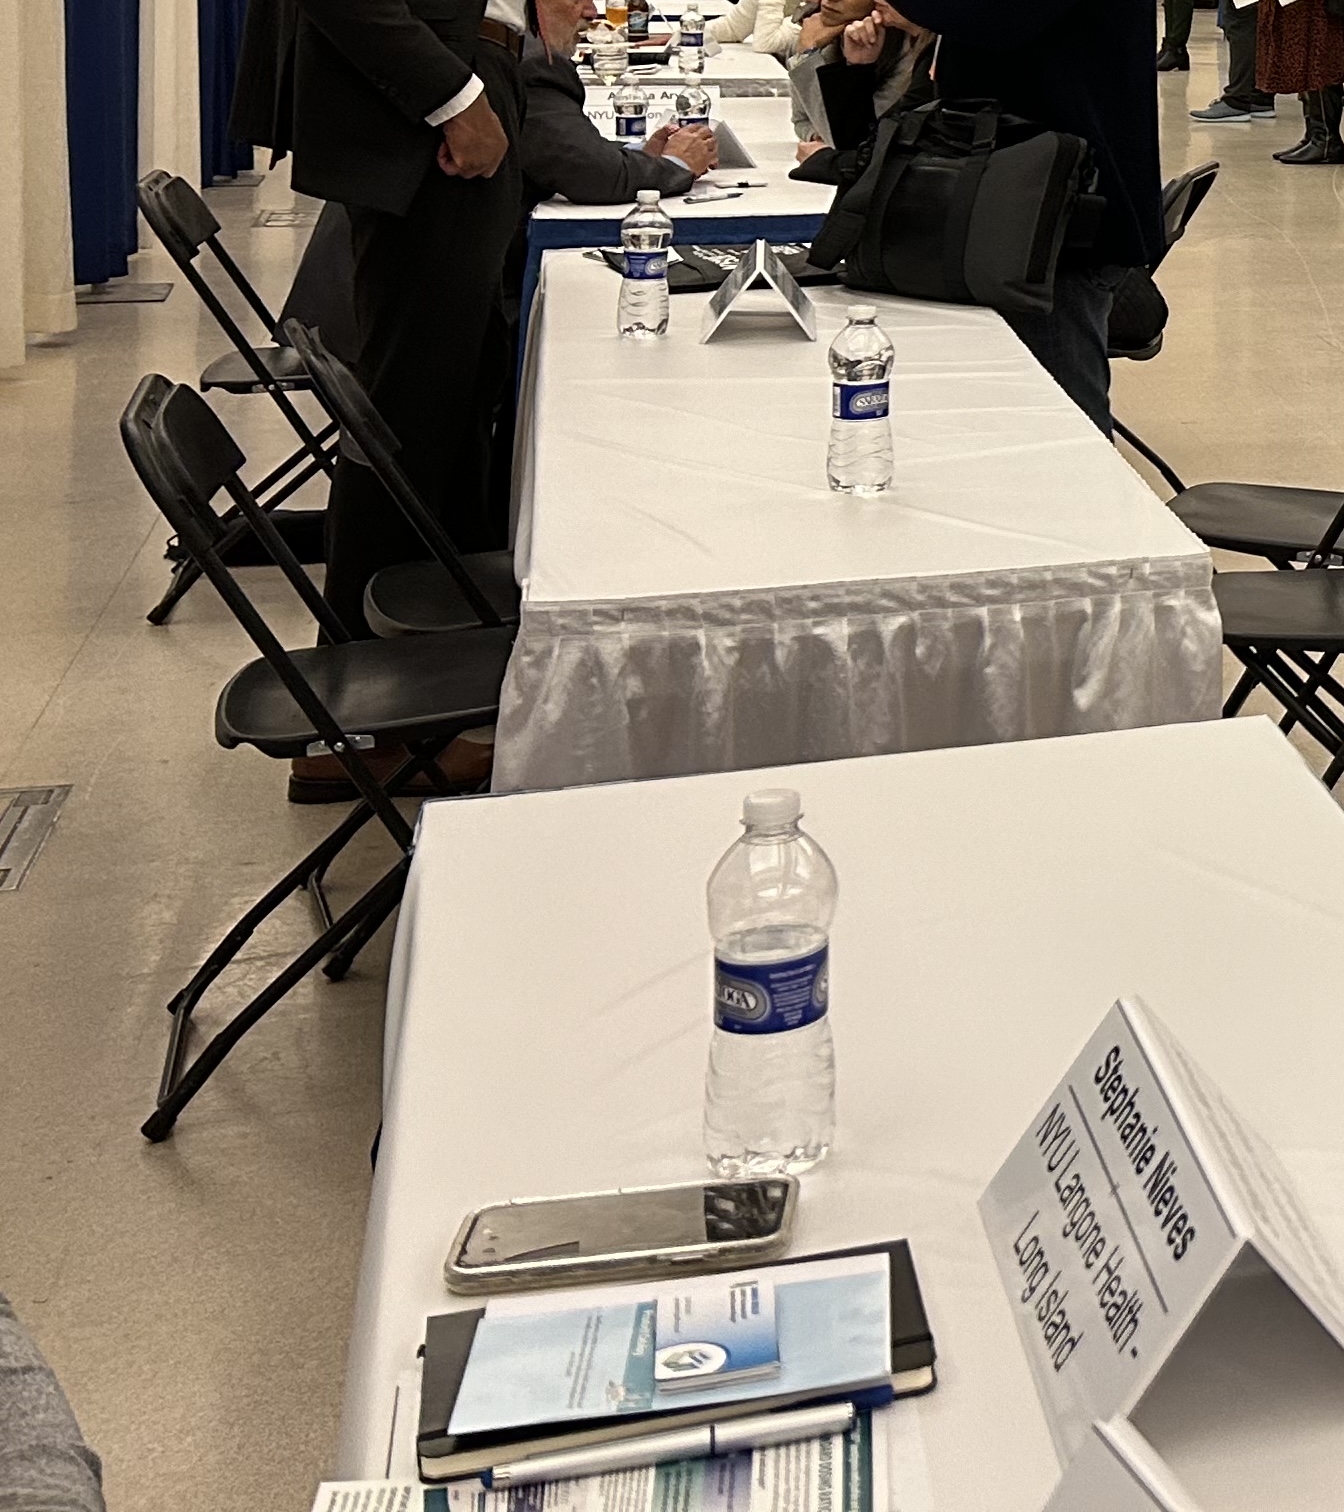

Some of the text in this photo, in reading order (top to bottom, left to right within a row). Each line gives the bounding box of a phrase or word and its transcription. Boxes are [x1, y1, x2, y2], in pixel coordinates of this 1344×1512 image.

[1035, 1102, 1076, 1173] NYU
[1094, 1045, 1196, 1262] Stephanie Nieves
[1054, 1148, 1107, 1270] Langone
[1013, 1210, 1085, 1373] Long Island
[1092, 1244, 1144, 1355] Health
